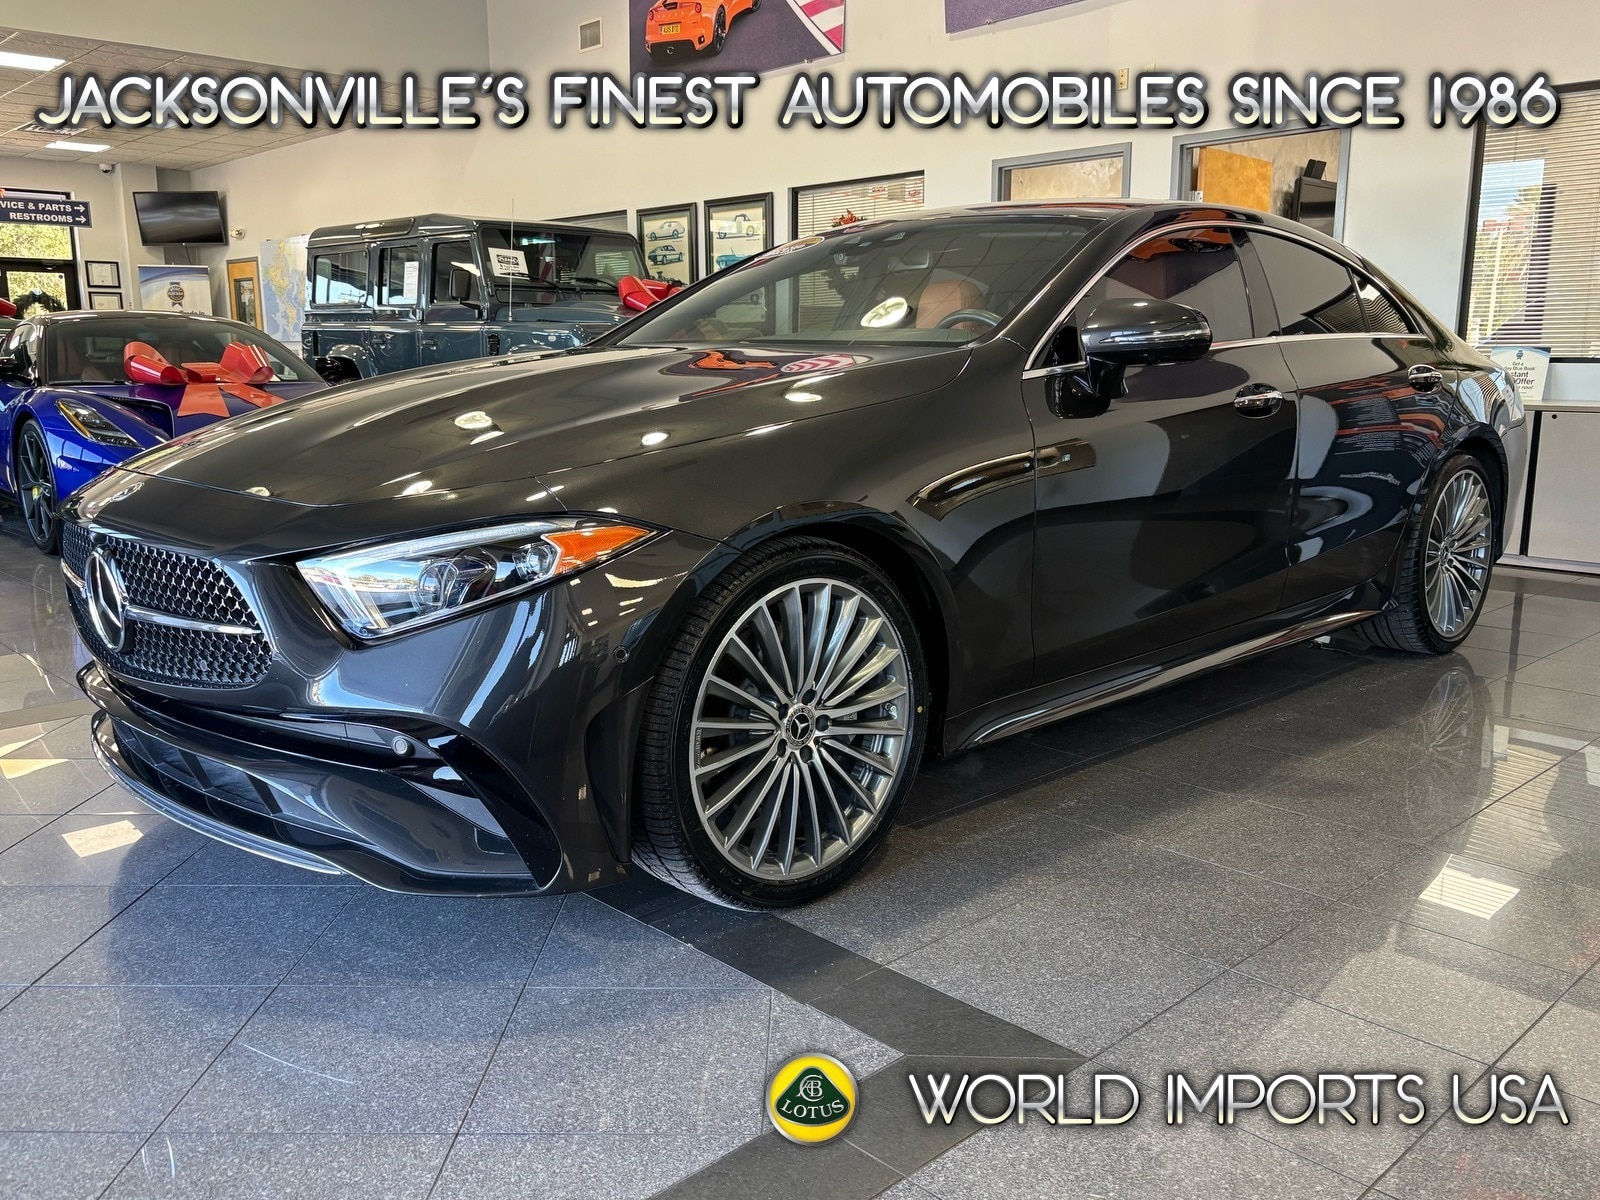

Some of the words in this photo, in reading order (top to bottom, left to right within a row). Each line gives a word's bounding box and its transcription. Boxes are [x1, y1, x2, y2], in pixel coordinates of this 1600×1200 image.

[28, 202, 35, 210] &
[38, 203, 72, 212] PARTS
[9, 212, 73, 223] RESTROOMS
